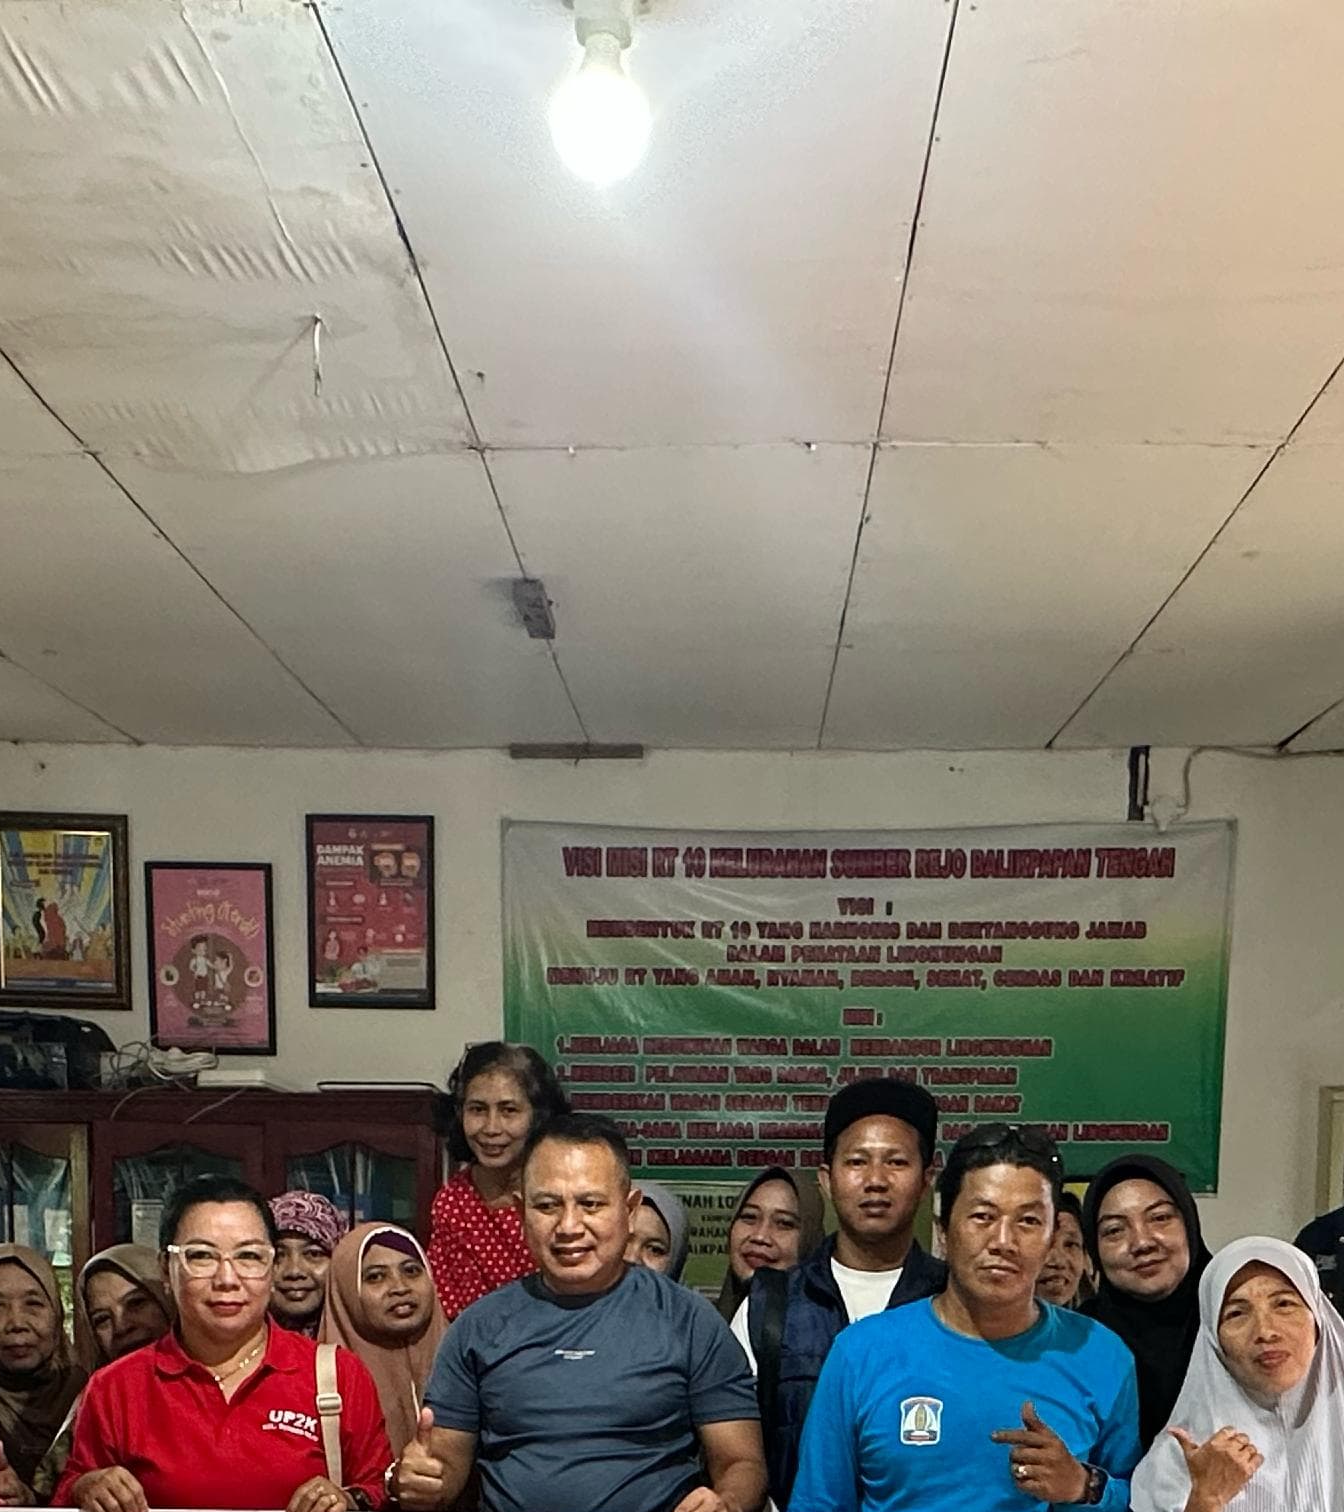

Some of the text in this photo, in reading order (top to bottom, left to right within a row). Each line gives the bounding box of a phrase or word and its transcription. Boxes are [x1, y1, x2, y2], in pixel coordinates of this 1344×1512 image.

[316, 844, 364, 855] DAMPAK
[316, 855, 364, 866] ANEMIA
[562, 847, 601, 877] VISI
[653, 847, 678, 877] RT
[709, 848, 827, 878] KELURAHAN
[831, 849, 911, 878] SUMBER
[915, 849, 967, 878] REJO
[970, 849, 1092, 878] BALIKPAPAN
[1095, 848, 1175, 877] TENGAH
[837, 898, 873, 915] VISI
[701, 921, 725, 939] RT
[756, 921, 803, 939] YANG
[907, 921, 942, 939] DAN
[948, 921, 1080, 939] BERTANGGUNG
[1085, 921, 1147, 939] JAWAB
[727, 945, 1002, 963] DALAM PENATAAN LINGKUNGAN
[547, 967, 618, 985] MENUJU
[624, 967, 647, 985] RT
[653, 968, 699, 985] YANG
[993, 970, 1062, 987] CERDAS
[1068, 970, 1104, 987] DAN
[1110, 970, 1185, 987] KREATIF
[269, 1410, 318, 1433] UP2K
